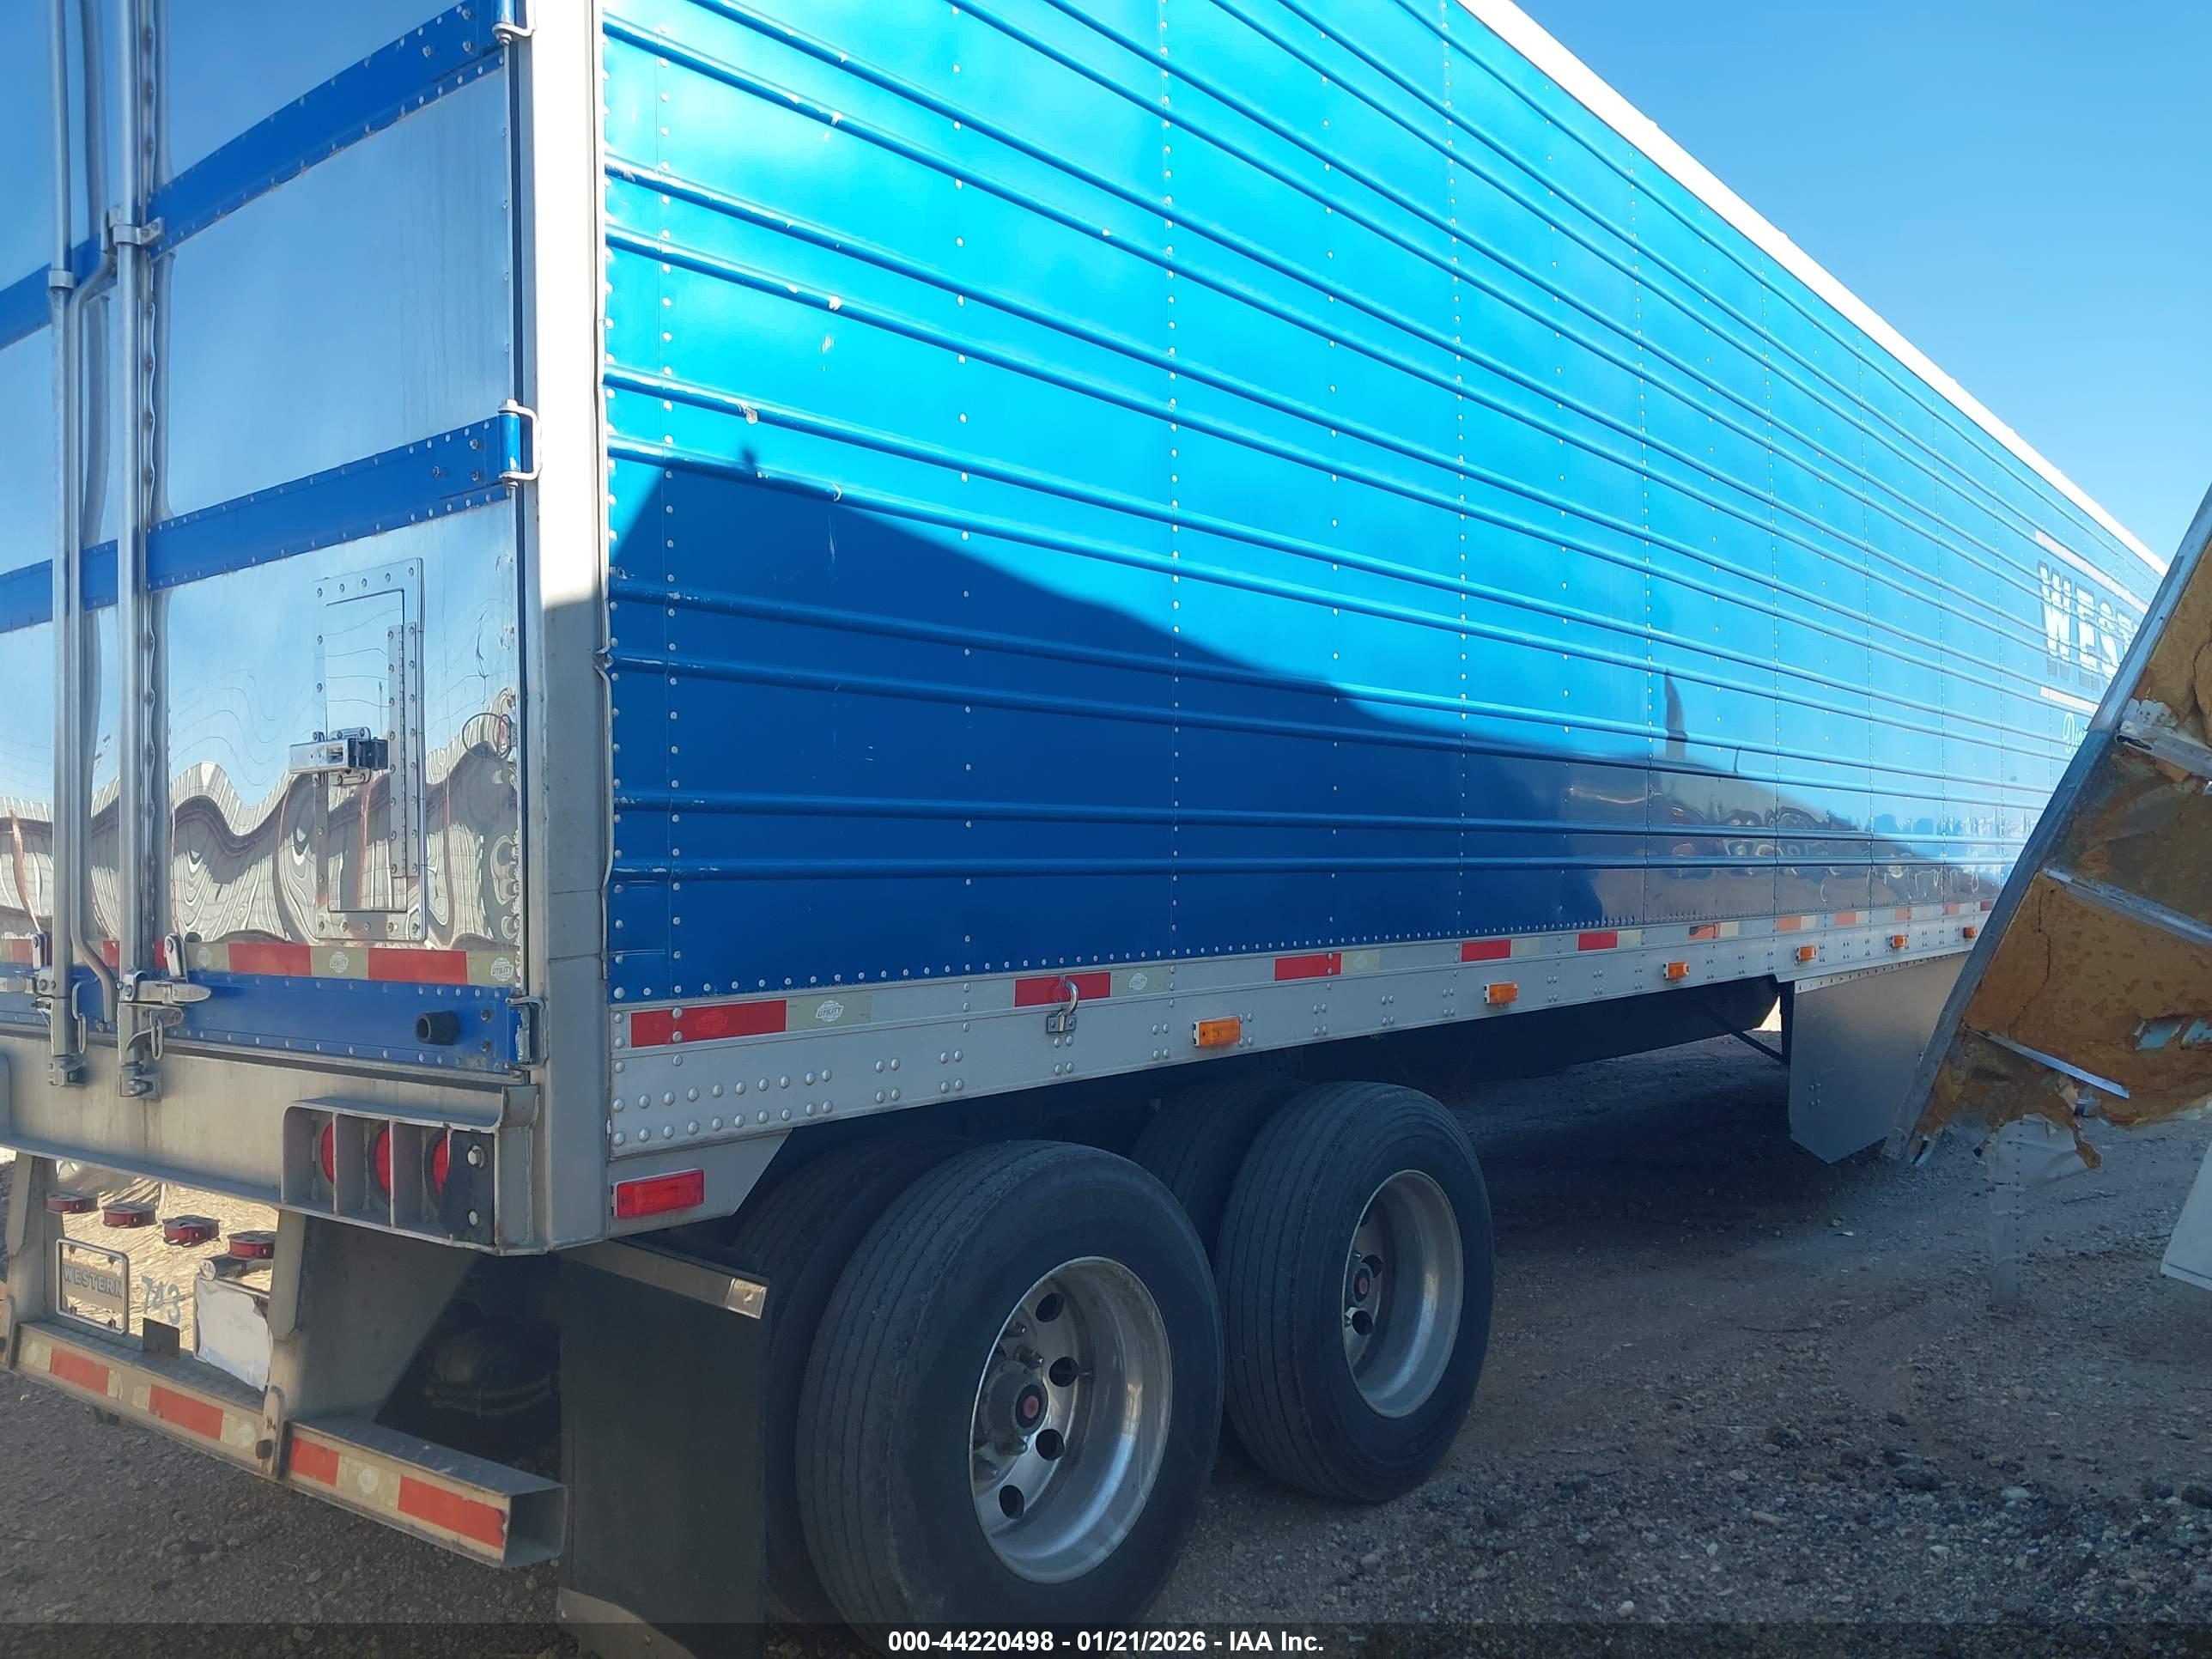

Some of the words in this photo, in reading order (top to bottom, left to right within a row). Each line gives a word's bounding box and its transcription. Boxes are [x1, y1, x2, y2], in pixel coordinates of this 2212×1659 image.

[2039, 562, 2140, 685] WEST
[490, 963, 514, 976] UTILITY
[816, 1005, 844, 1019] UTILITY
[63, 1264, 123, 1298] WESTERN
